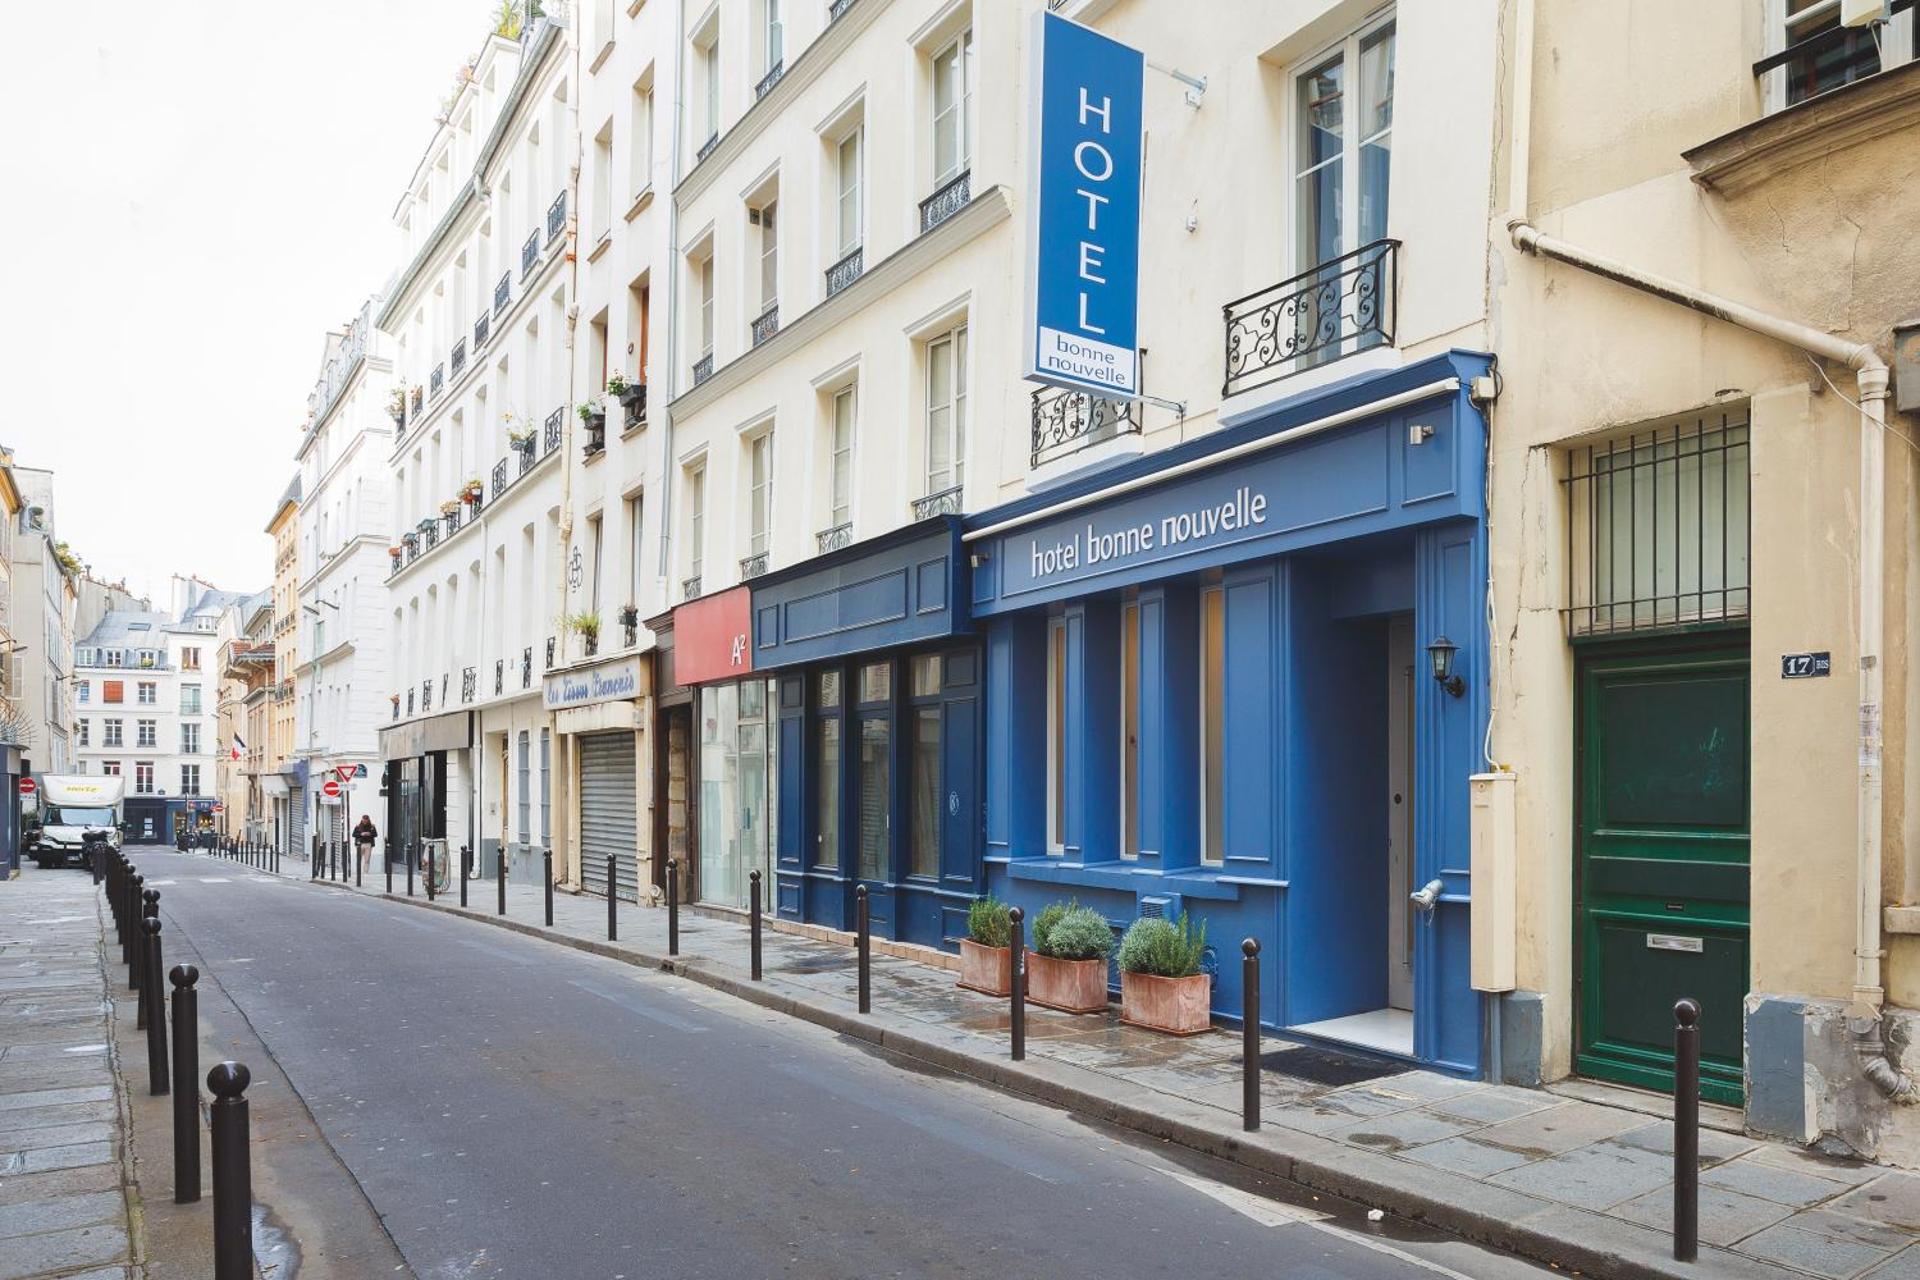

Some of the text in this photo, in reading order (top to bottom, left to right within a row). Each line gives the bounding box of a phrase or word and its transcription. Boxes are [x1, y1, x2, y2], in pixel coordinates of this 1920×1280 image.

[1074, 87, 1113, 334] HOTEL
[1057, 334, 1115, 364] bonne
[1048, 355, 1125, 385] nouvelle
[1032, 487, 1267, 578] hotel bonne nouvelle
[1787, 657, 1811, 674] 17
